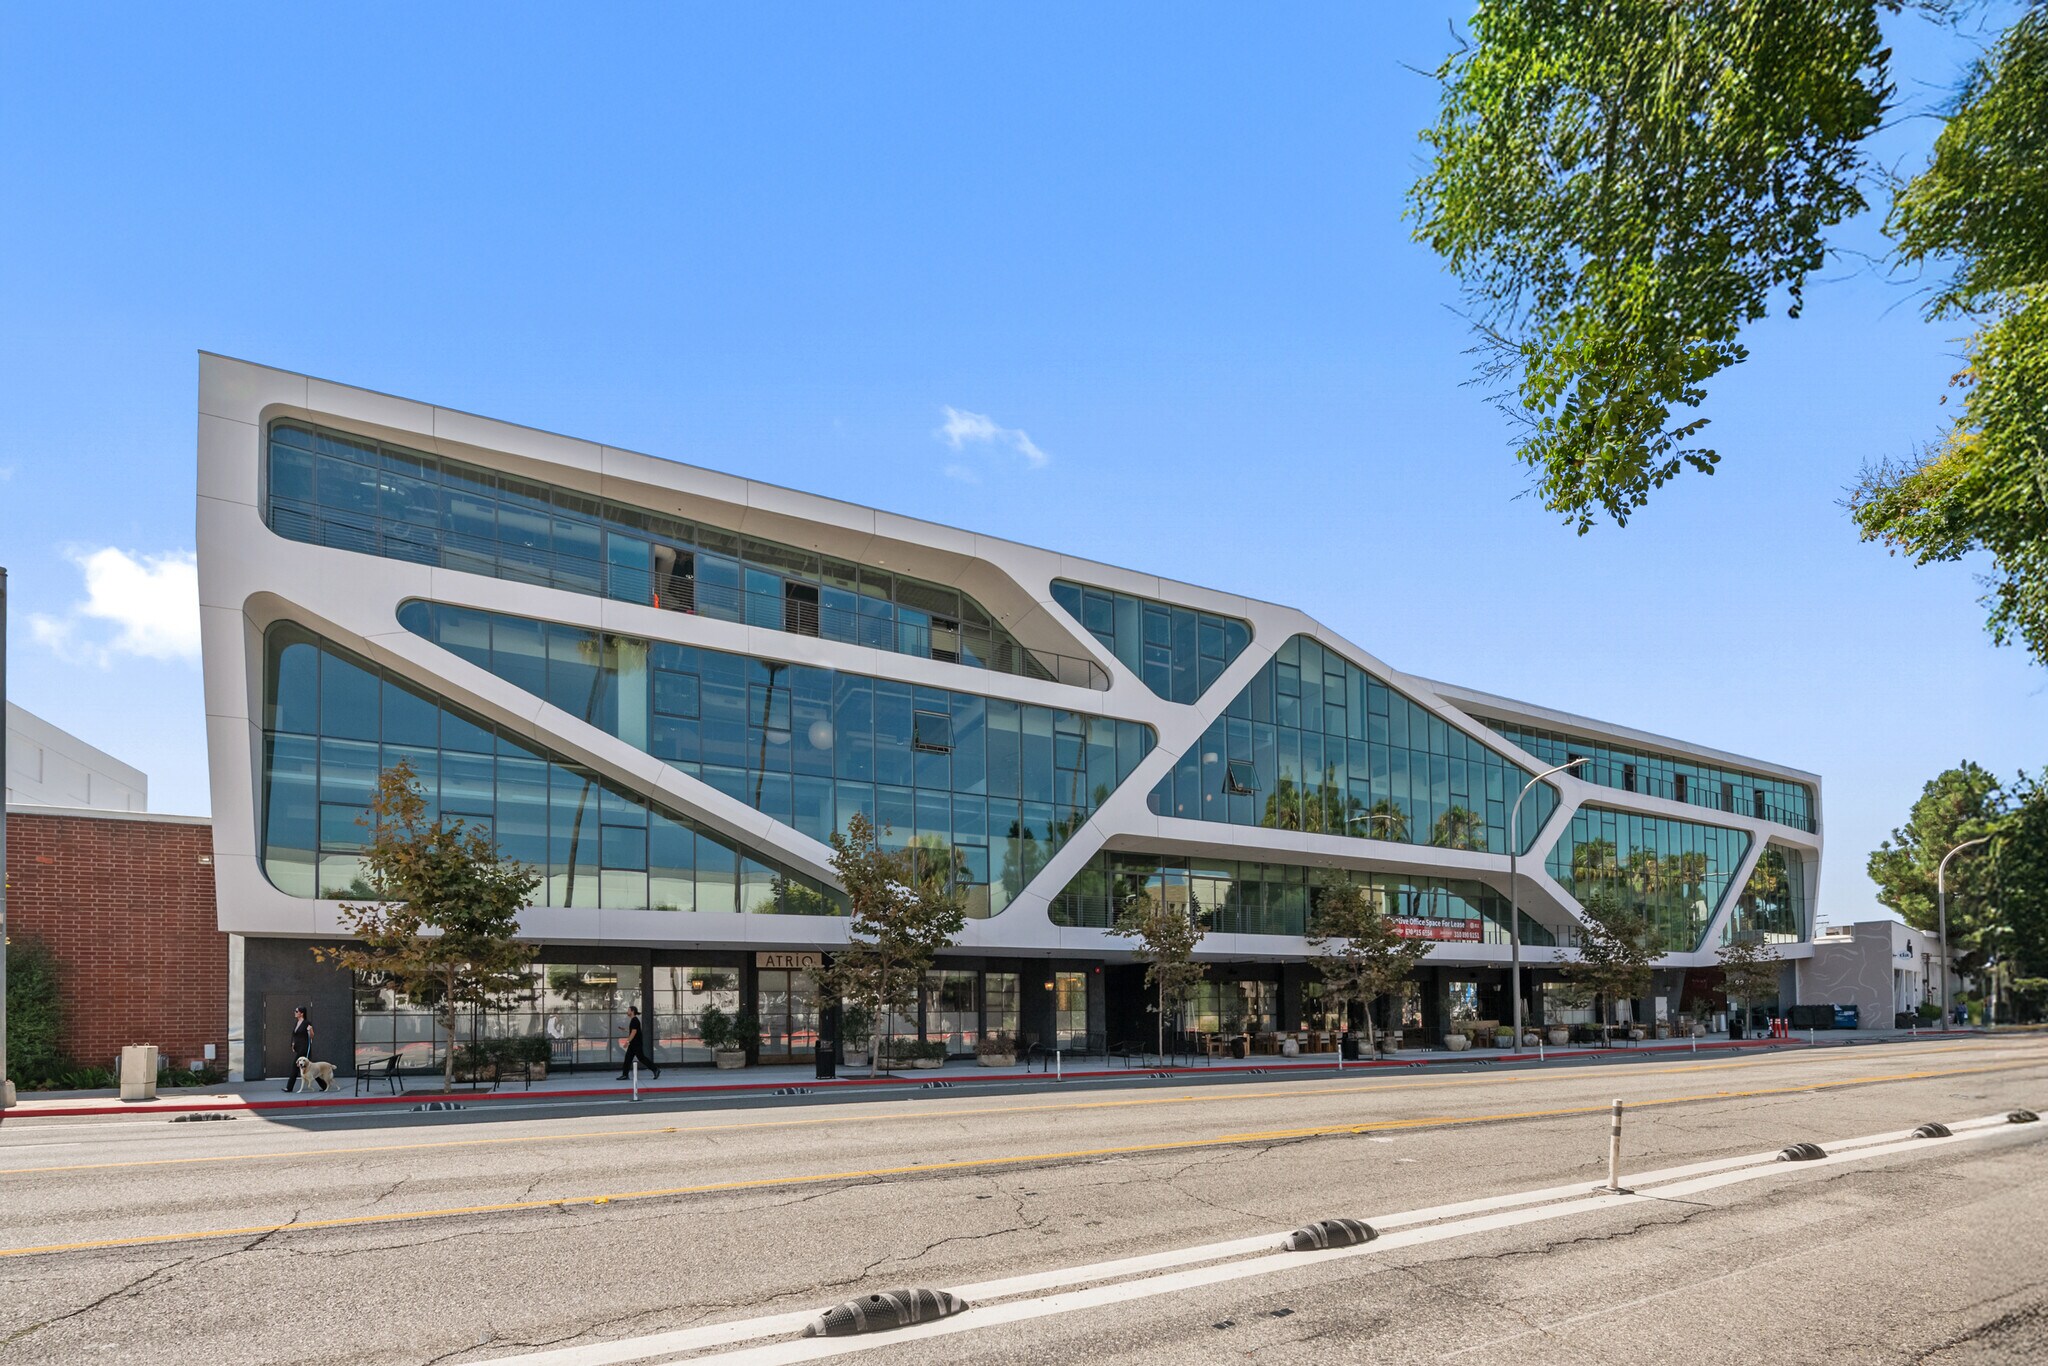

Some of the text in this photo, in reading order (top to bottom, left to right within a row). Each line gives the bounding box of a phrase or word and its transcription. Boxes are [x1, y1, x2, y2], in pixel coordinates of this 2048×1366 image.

[1409, 917, 1425, 926] Office
[1426, 918, 1441, 928] Space
[1441, 919, 1450, 927] For
[1450, 920, 1465, 928] Lease
